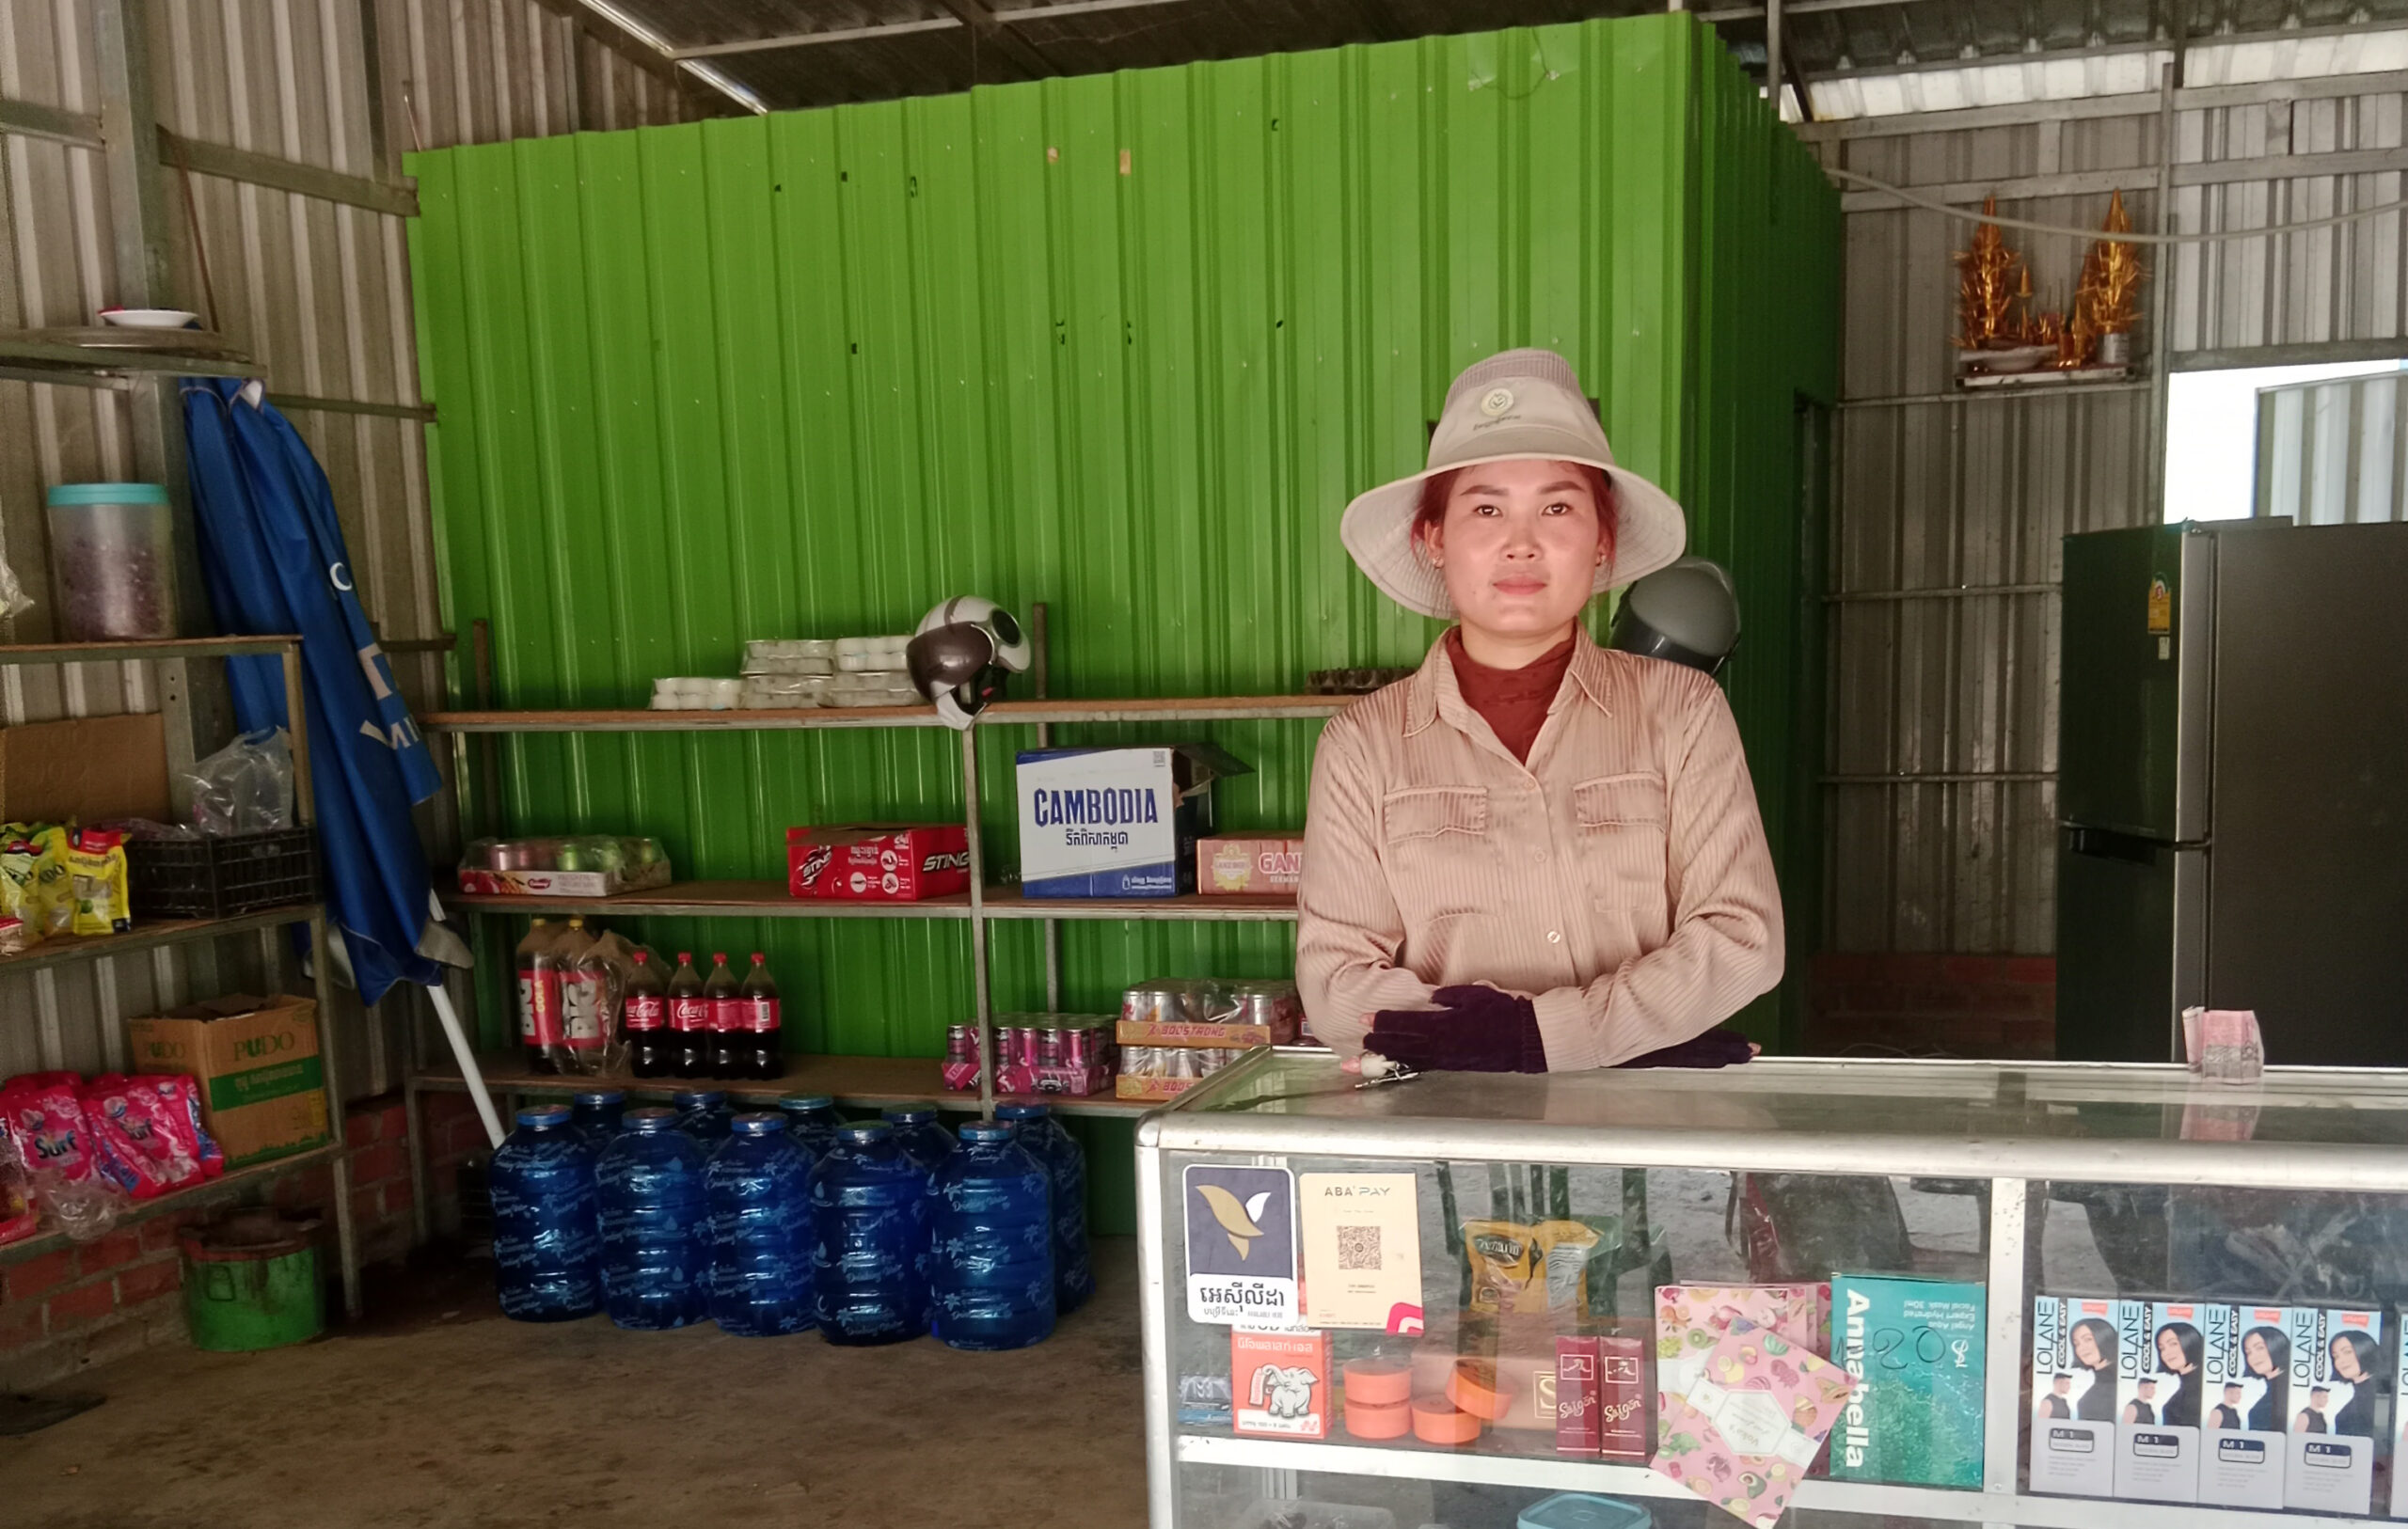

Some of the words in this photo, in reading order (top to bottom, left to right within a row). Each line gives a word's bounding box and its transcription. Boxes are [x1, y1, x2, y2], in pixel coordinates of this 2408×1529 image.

[1035, 787, 1158, 828] CAMBODIA
[1259, 852, 1303, 874] GAN
[533, 981, 546, 1014] COLA
[234, 1031, 295, 1062] PUDO
[34, 1129, 78, 1159] Surf
[1324, 1187, 1353, 1196] ABA
[1358, 1187, 1390, 1196] PAY
[2059, 1302, 2067, 1327] EASY
[2144, 1306, 2152, 1331] EASY
[2230, 1311, 2239, 1335] EASY
[2317, 1314, 2326, 1338] EASY
[2036, 1301, 2057, 1374] LOLANE
[2121, 1306, 2142, 1379] LOLANE
[2207, 1309, 2227, 1383] LOLANE
[2293, 1313, 2315, 1387] LOLANE
[2057, 1339, 2067, 1366] COOL
[2142, 1344, 2151, 1371] COOL
[2228, 1348, 2238, 1375] COOL
[2315, 1350, 2324, 1379] COOL
[2052, 1430, 2065, 1439] M
[2137, 1435, 2151, 1443] M
[2222, 1441, 2235, 1449] M
[2307, 1444, 2321, 1453] M
